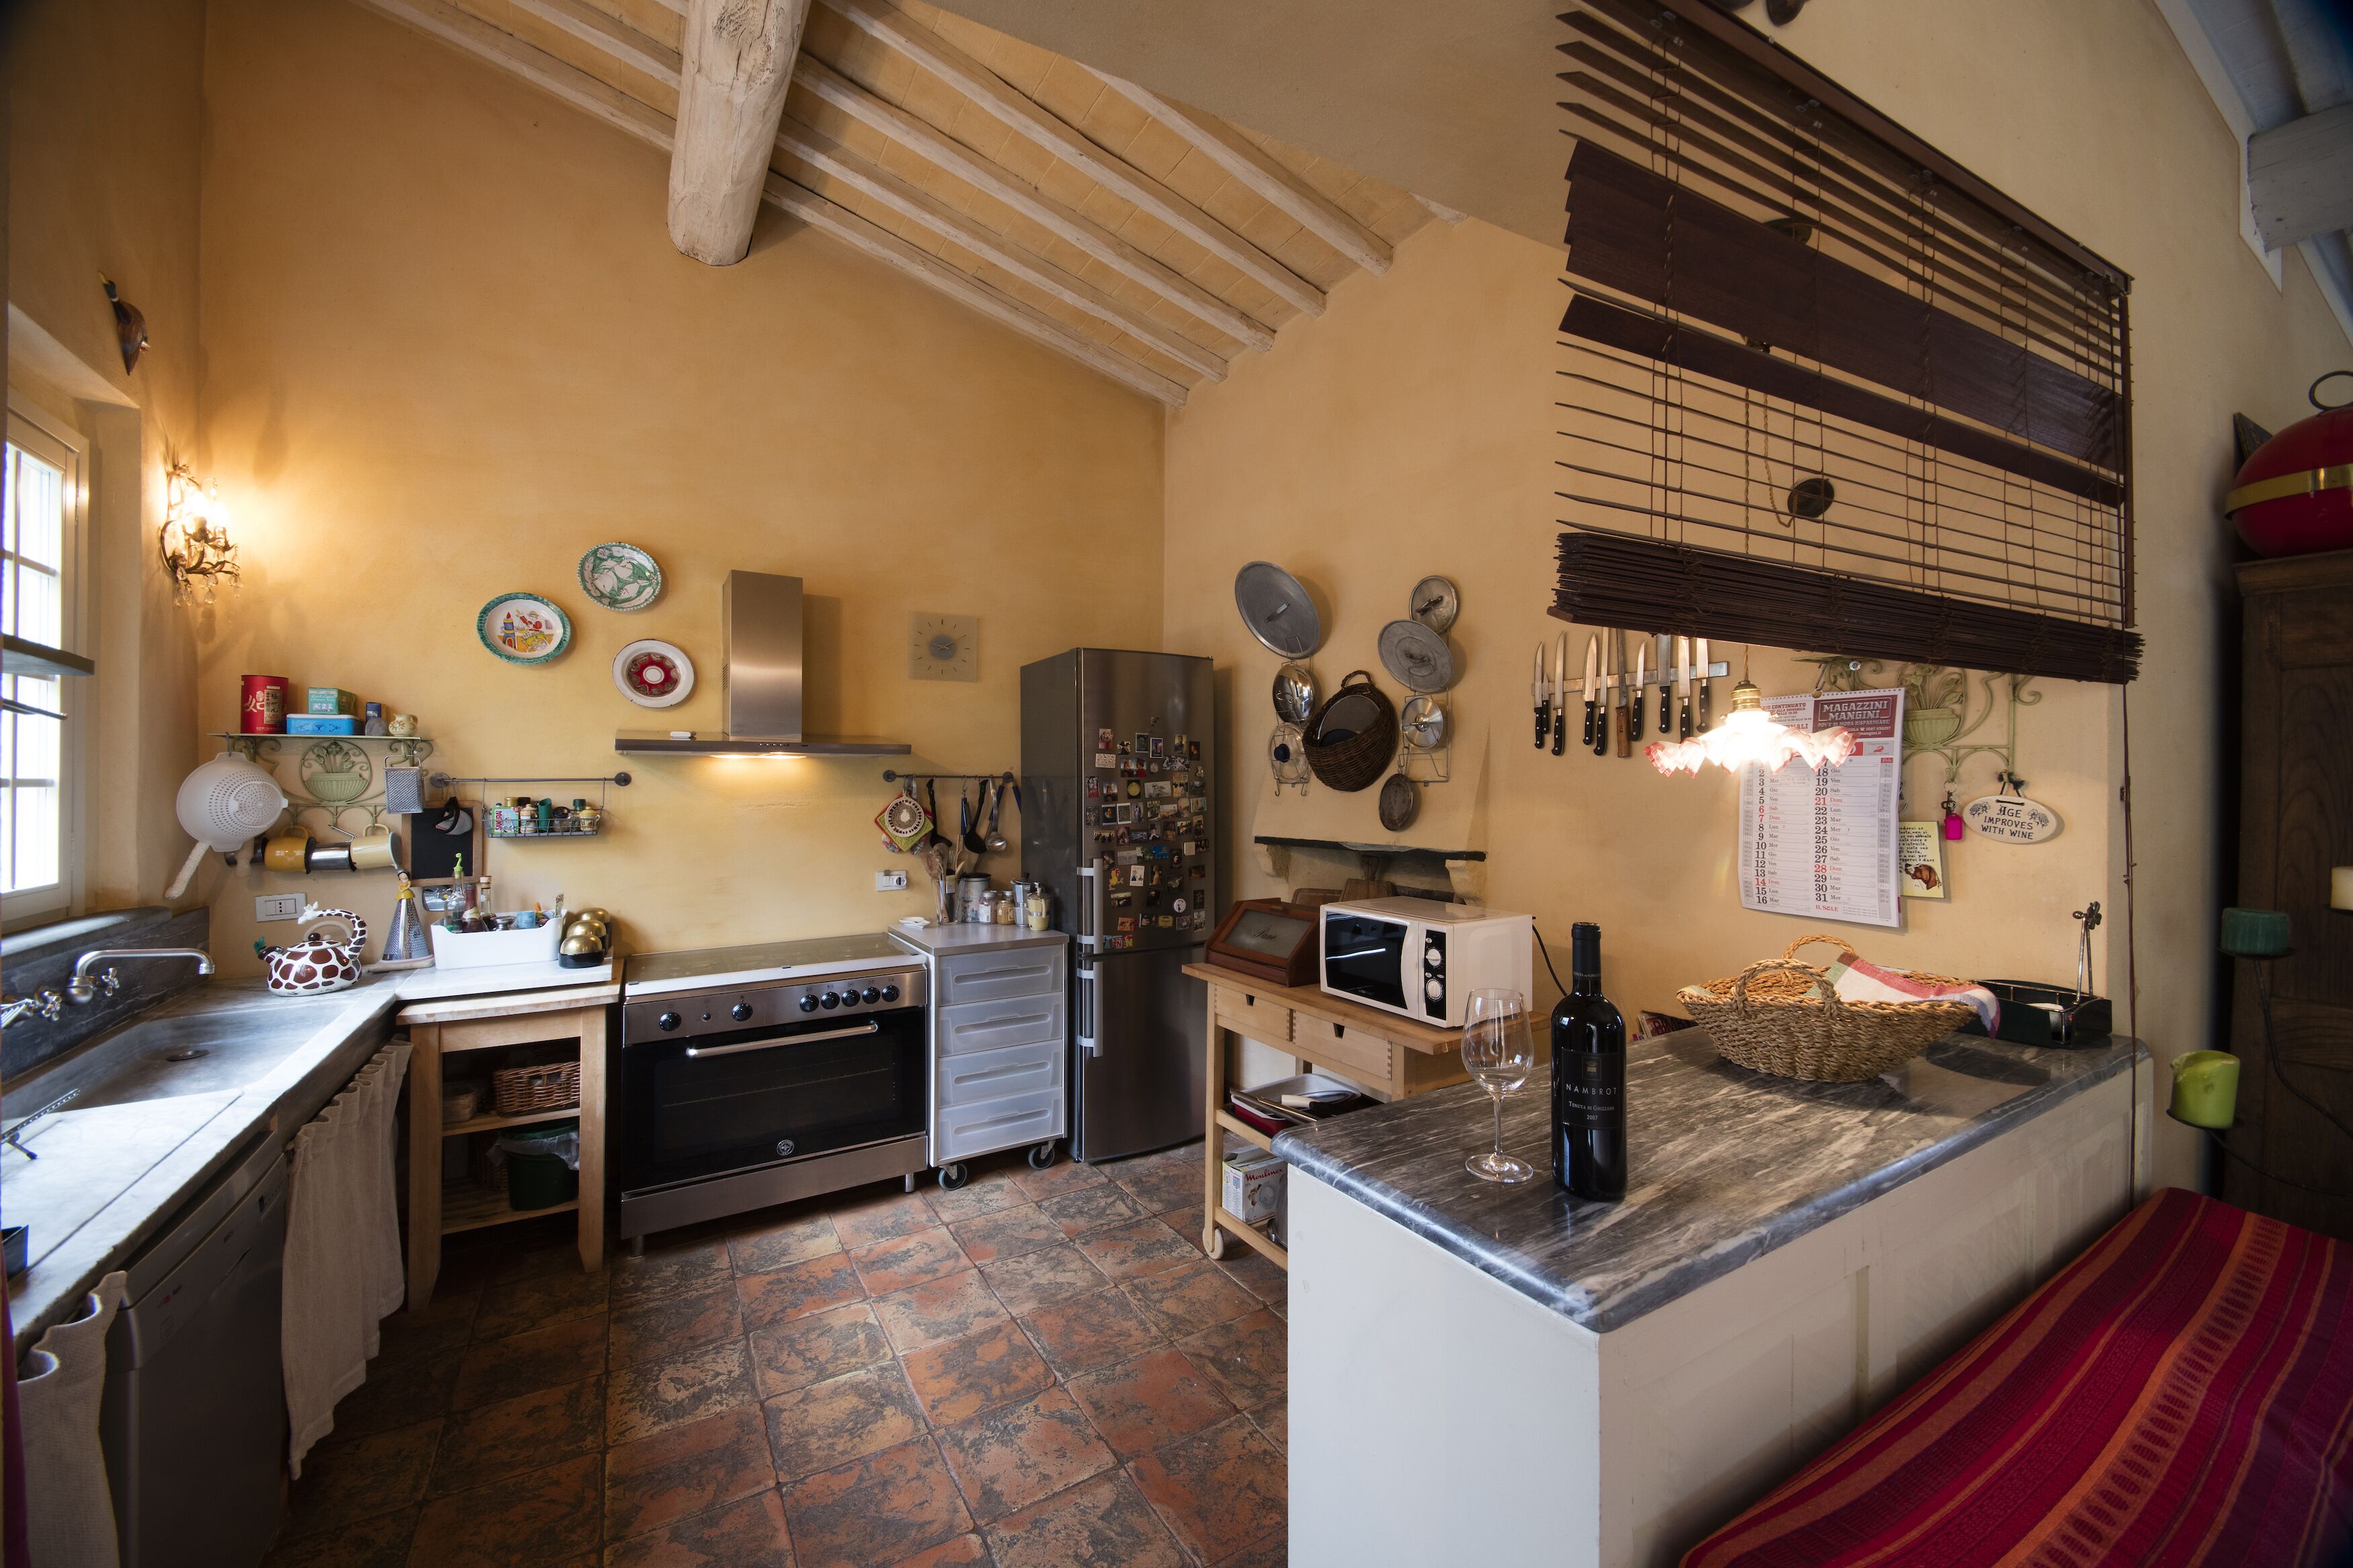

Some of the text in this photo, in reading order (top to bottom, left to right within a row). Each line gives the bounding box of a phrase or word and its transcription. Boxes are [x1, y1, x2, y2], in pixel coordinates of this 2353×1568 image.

[1823, 700, 1888, 712] MAGAZZINI
[1829, 710, 1880, 721] MANGINI
[1759, 769, 1765, 777] 2
[1816, 768, 1829, 777] 18
[1759, 778, 1765, 786] 3
[1816, 778, 1828, 786] 19
[1759, 787, 1765, 795] 4
[1815, 788, 1828, 796] 20
[1759, 796, 1764, 804] 5
[1815, 797, 1827, 805] 21
[1759, 805, 1764, 813] 6
[1814, 807, 1827, 815] 22
[1997, 804, 2022, 818] AGE
[1759, 815, 1764, 823] 7
[1814, 816, 1827, 825] 23
[1984, 815, 2033, 830] IMPROVES
[1759, 823, 1764, 832] 8
[1815, 825, 1828, 835] 24
[1981, 824, 2034, 840] WITH WINE
[1759, 832, 1764, 841] 9
[1815, 835, 1827, 844] 25
[1755, 841, 1767, 850] 10
[1815, 845, 1827, 854] 26
[1755, 851, 1765, 859] 11
[1814, 854, 1827, 863] 27
[1755, 860, 1765, 868] 12
[1814, 864, 1827, 873] 28
[1755, 868, 1765, 877] 13
[1755, 878, 1767, 886] 14
[1814, 874, 1827, 883] 29
[1756, 886, 1767, 895] 15
[1815, 883, 1827, 893] 30
[1756, 895, 1767, 905] 16
[1815, 893, 1828, 902] 31
[1566, 1083, 1617, 1096] NAMBROT
[1568, 1101, 1587, 1110] TENUTA
[1245, 1168, 1284, 1182] Moulinex
